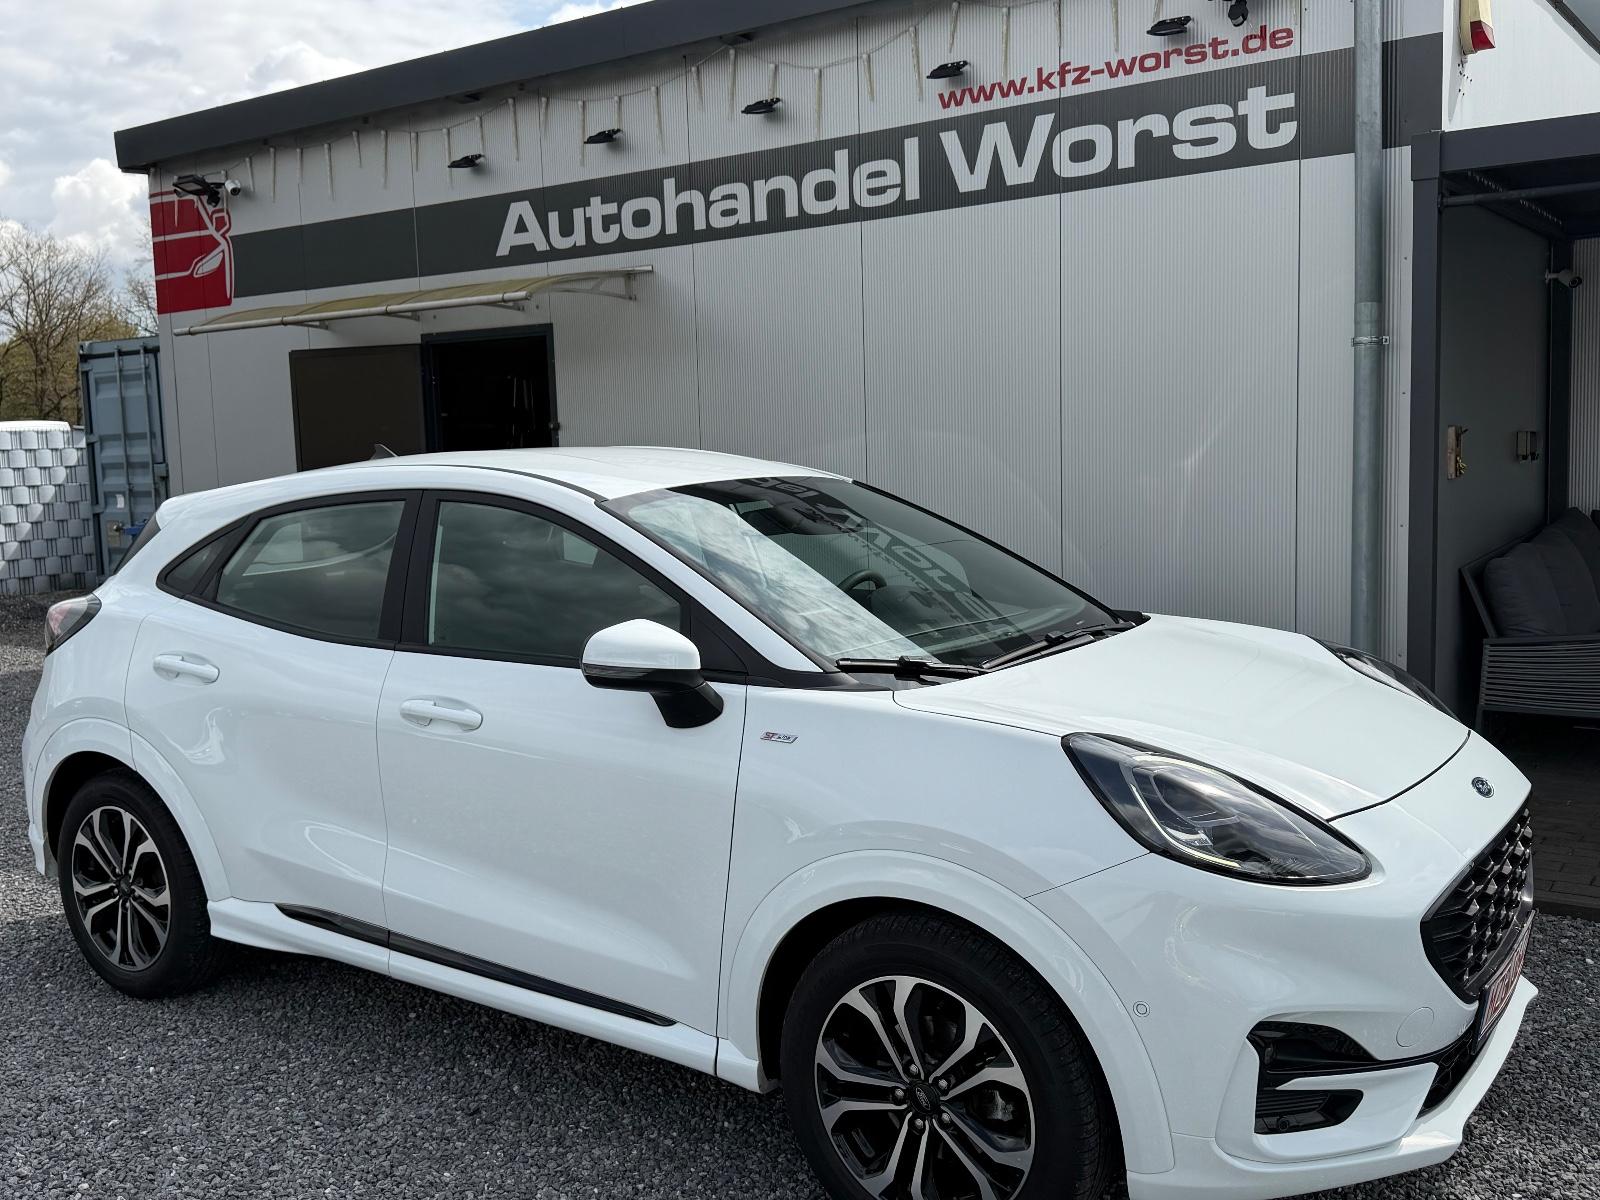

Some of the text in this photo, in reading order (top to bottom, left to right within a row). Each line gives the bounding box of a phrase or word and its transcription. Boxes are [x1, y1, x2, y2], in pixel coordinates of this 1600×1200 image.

[938, 25, 1294, 109] www.kfz-worst.de
[495, 85, 1297, 257] Autohandel Worst
